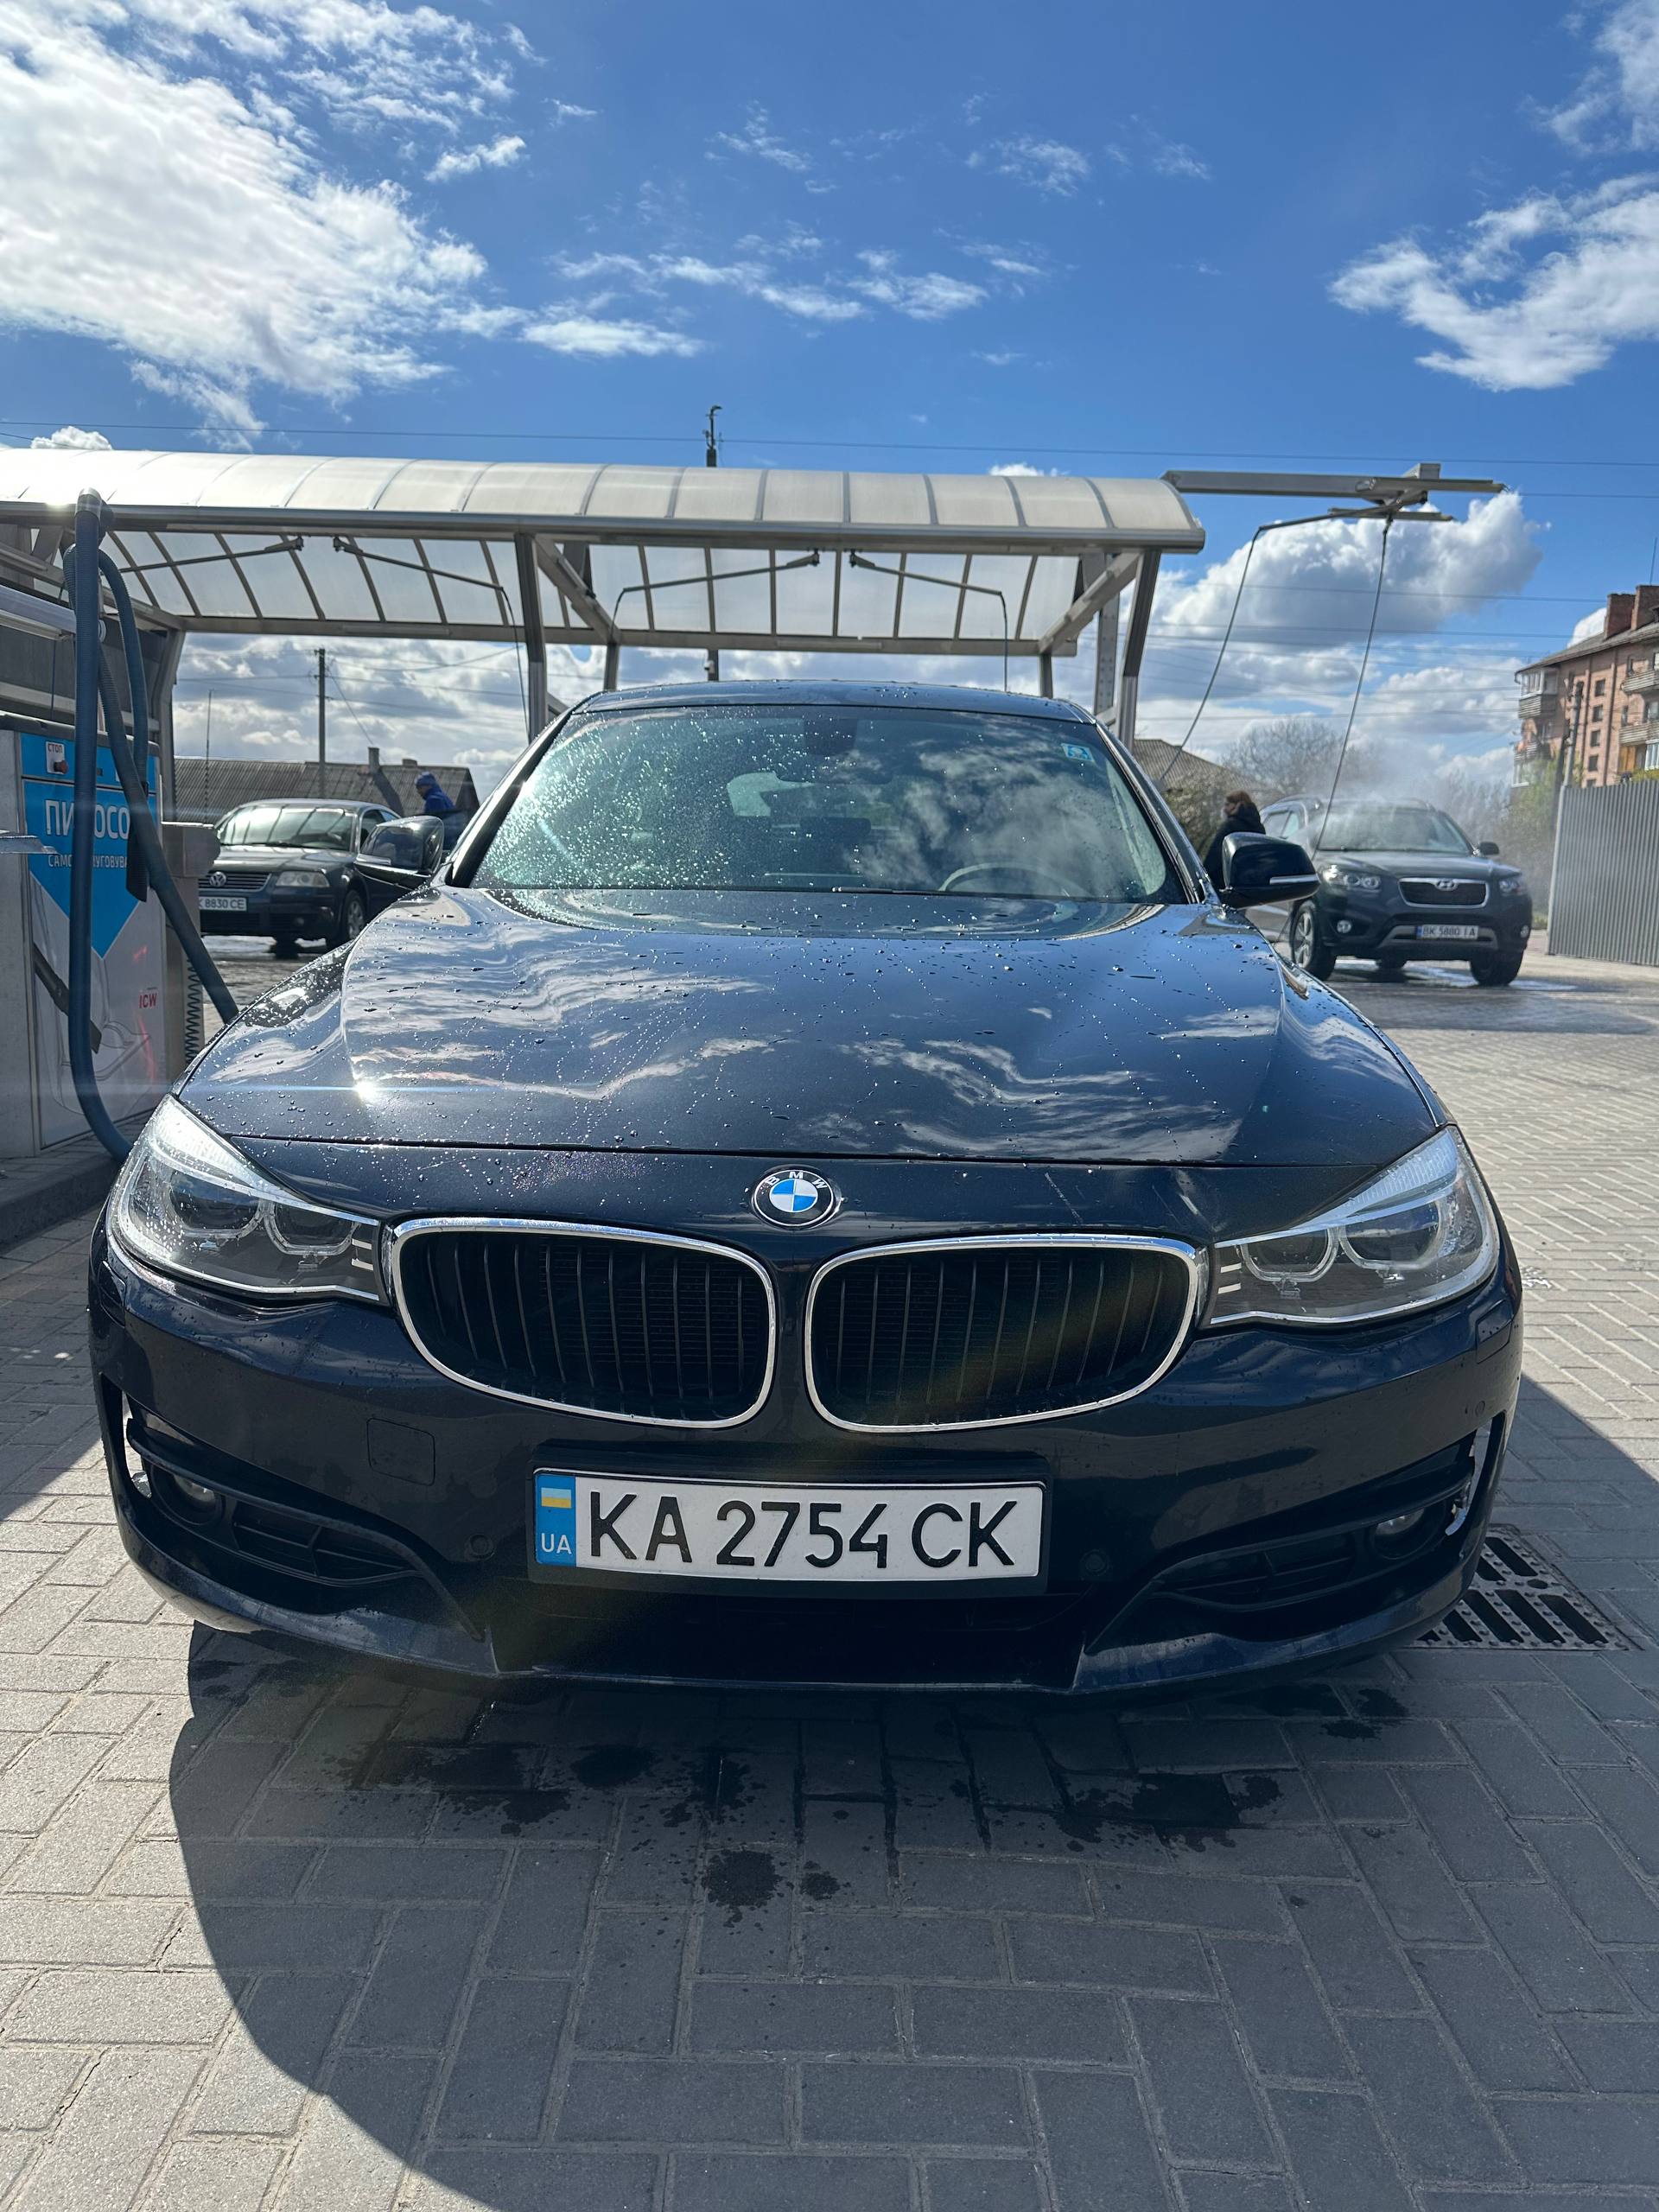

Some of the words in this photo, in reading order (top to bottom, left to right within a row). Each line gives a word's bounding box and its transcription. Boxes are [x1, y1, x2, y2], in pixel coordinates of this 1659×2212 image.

[48, 743, 63, 753] СТОП
[45, 799, 130, 840] ПИОСО
[139, 993, 157, 1008] ICW
[765, 1171, 828, 1189] BMW
[590, 1491, 693, 1563] KA
[716, 1500, 887, 1569] 2754
[912, 1501, 1018, 1568] CK
[541, 1533, 572, 1555] UA
